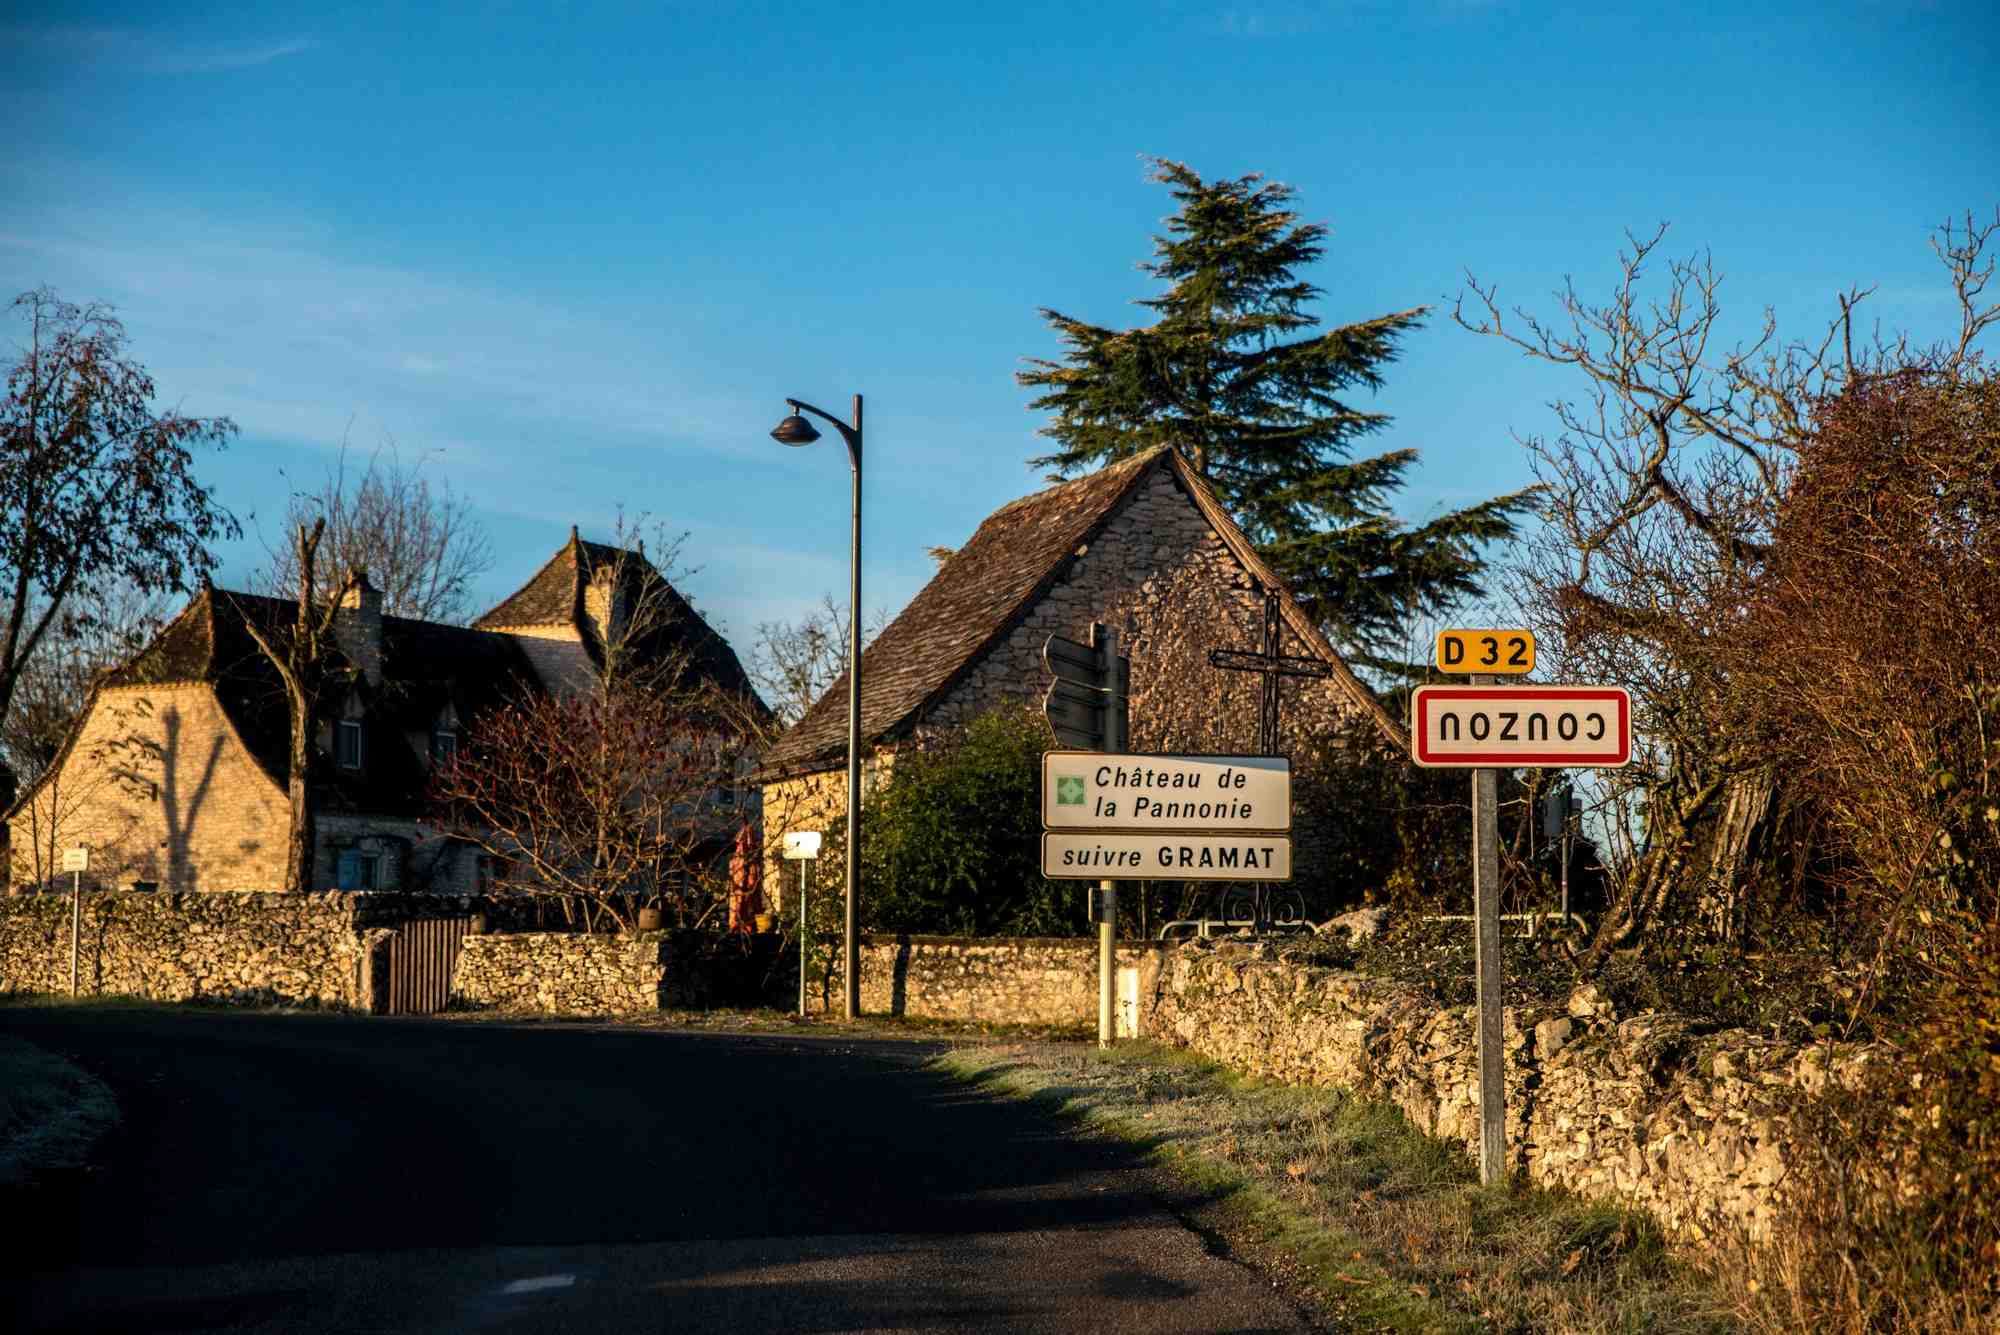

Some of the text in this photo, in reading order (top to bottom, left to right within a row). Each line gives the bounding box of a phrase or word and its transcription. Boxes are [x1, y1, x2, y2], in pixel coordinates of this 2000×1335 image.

[1444, 637, 1528, 665] D 32
[1440, 712, 1605, 741] COUZOU
[1095, 766, 1247, 789] Château de
[1095, 796, 1252, 819] la Pannonie
[1062, 845, 1275, 868] suivre GRAMAT
